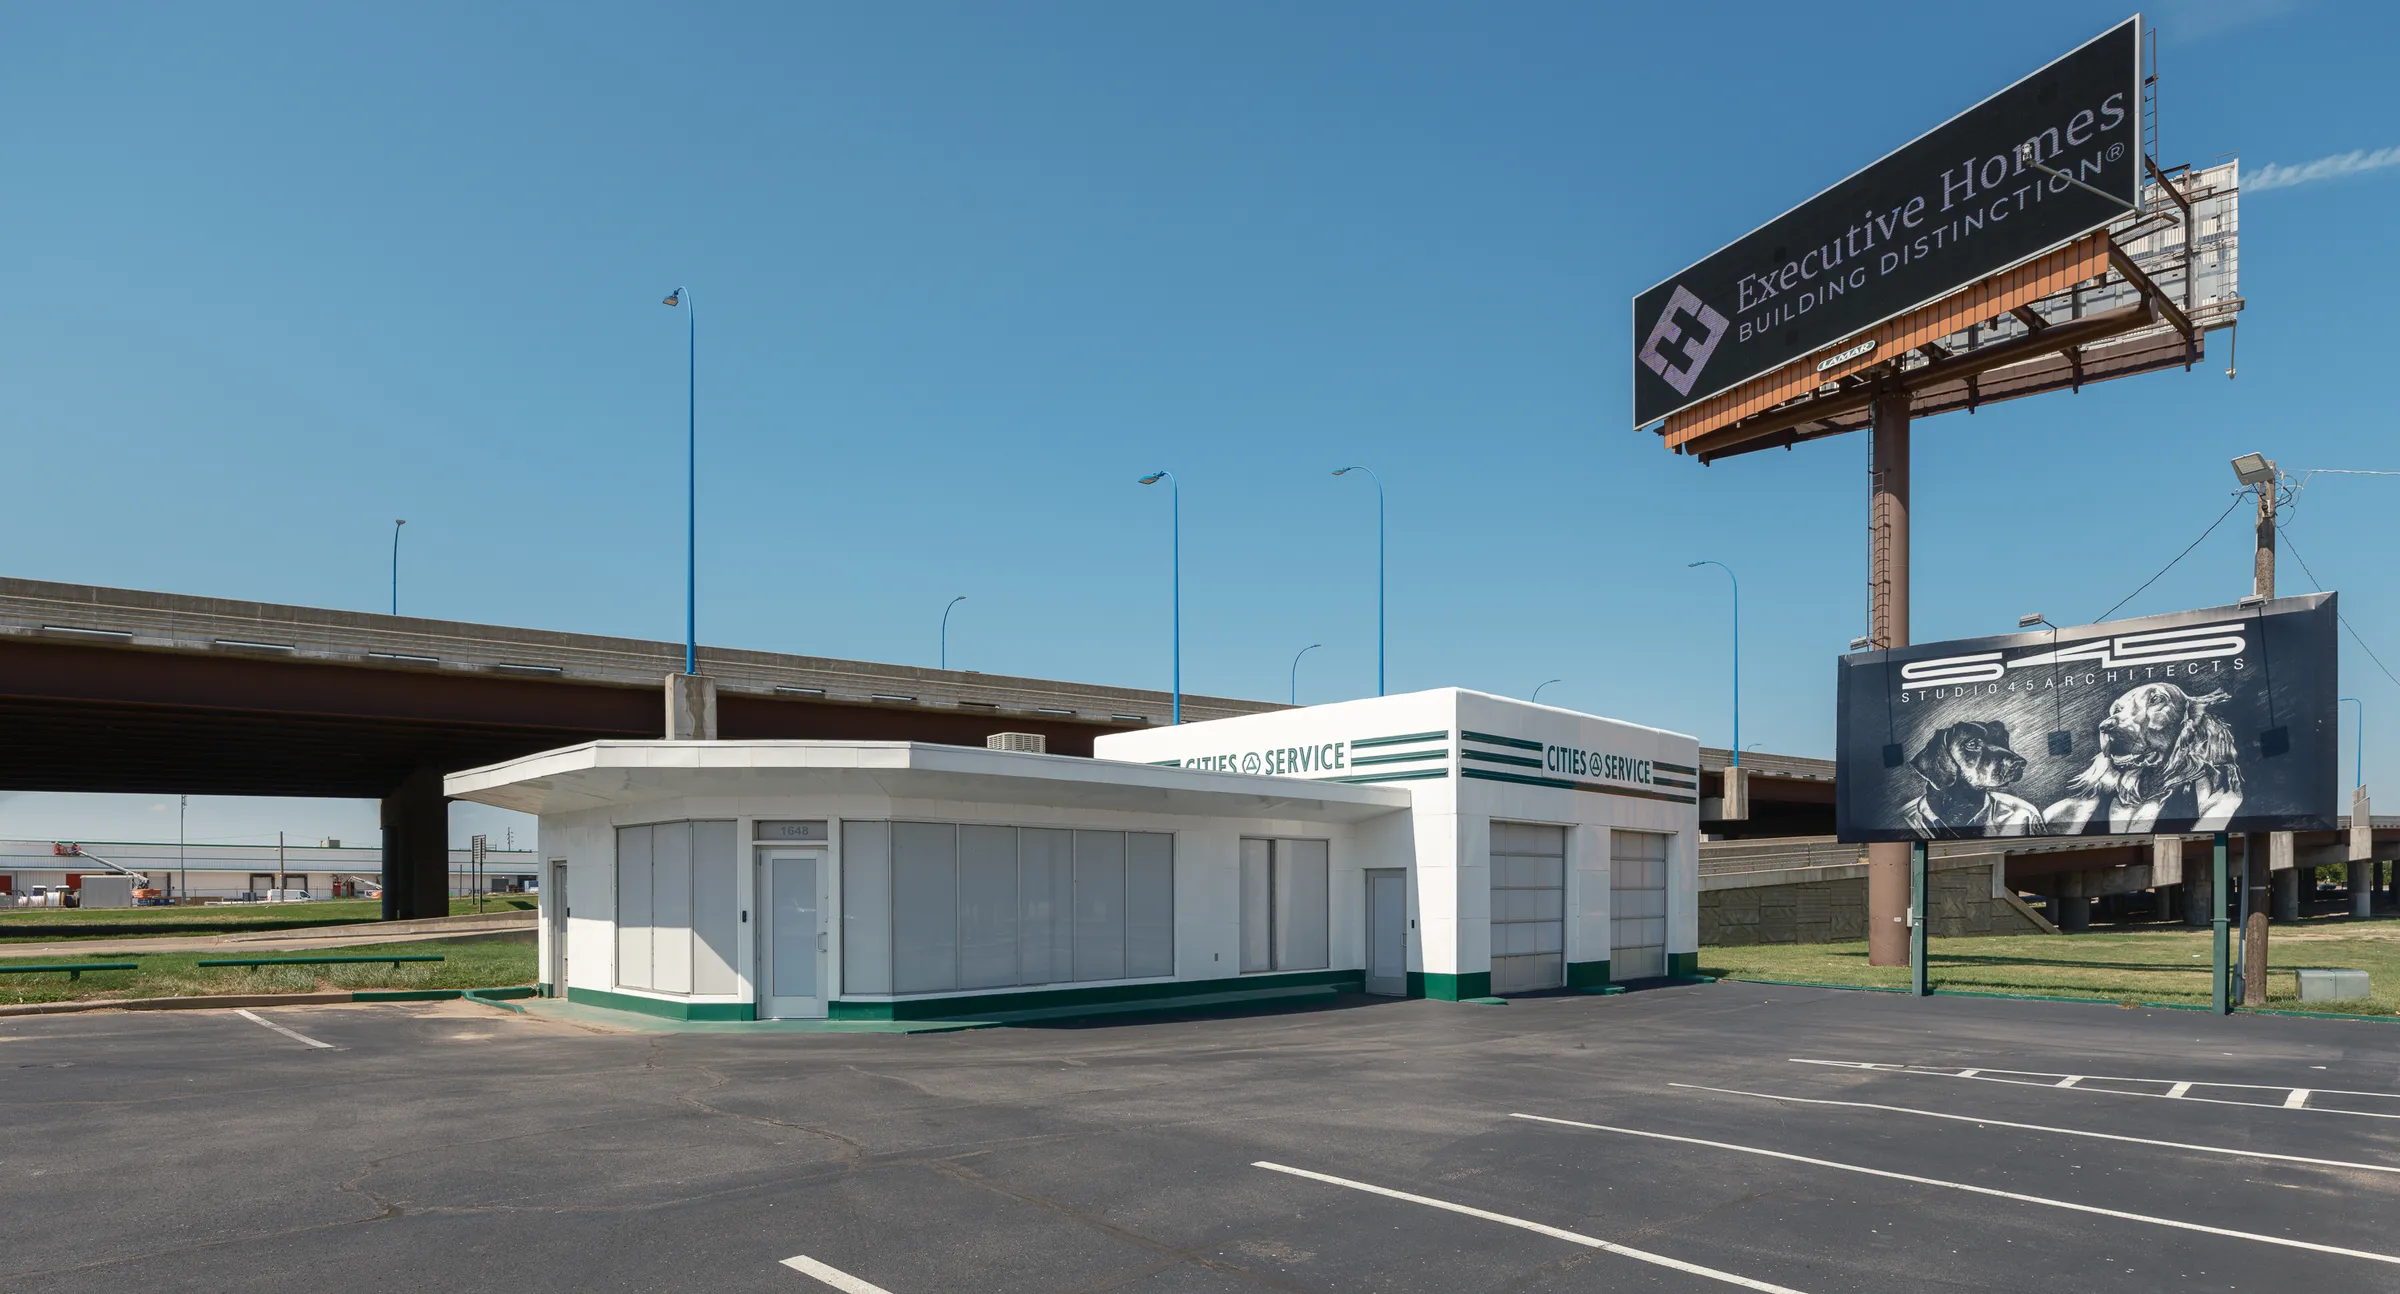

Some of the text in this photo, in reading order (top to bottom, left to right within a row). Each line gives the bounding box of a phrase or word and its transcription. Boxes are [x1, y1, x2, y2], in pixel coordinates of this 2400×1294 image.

[1737, 92, 2125, 314] Executive Homes
[1739, 267, 1866, 343] BUILDING
[1821, 343, 1870, 367] LAMAR
[1265, 742, 1345, 775] SERVICE
[1547, 745, 1651, 784] CITIES SERVICE
[780, 826, 809, 836] 1648
